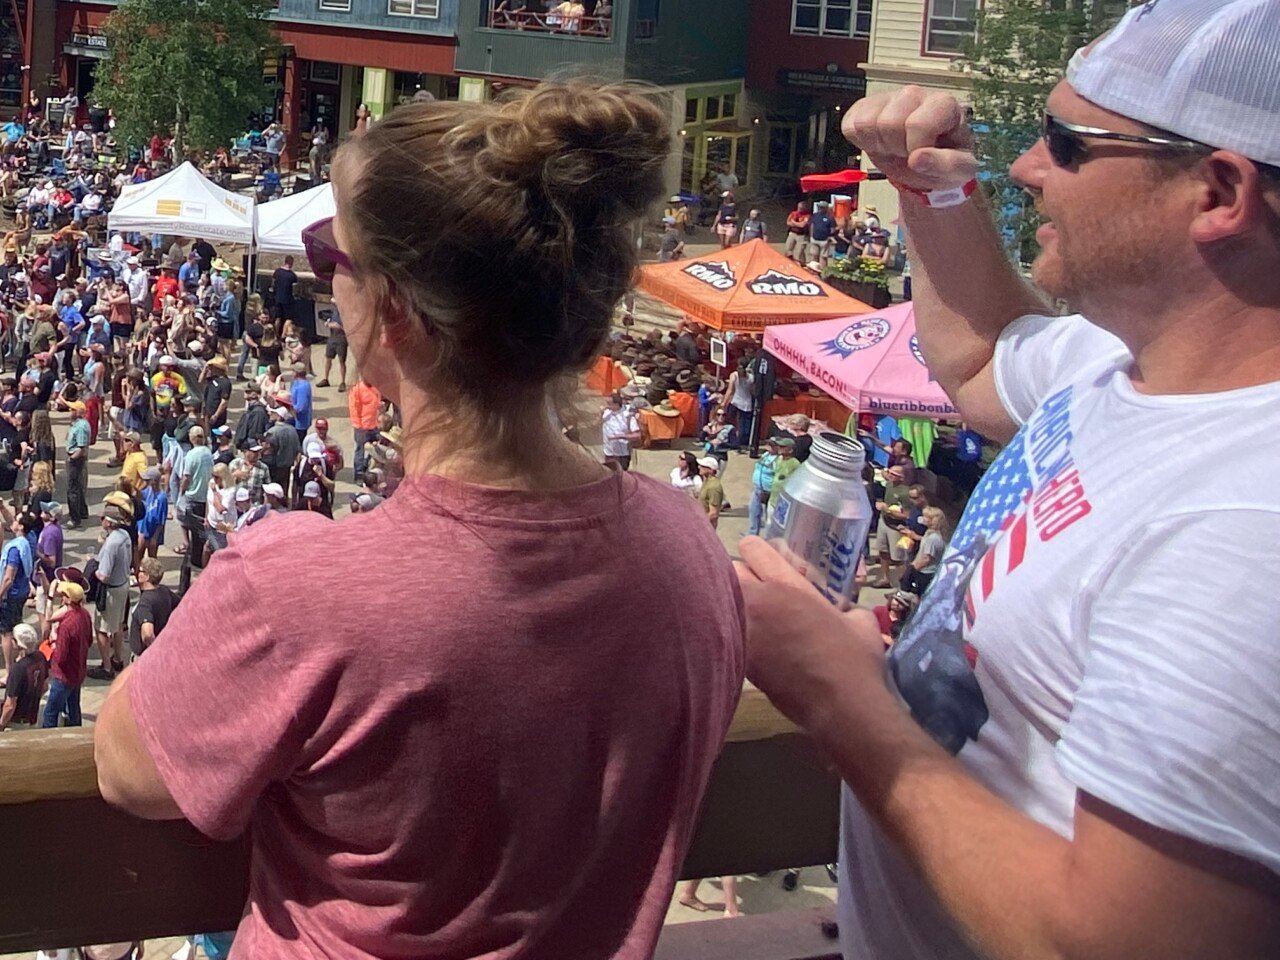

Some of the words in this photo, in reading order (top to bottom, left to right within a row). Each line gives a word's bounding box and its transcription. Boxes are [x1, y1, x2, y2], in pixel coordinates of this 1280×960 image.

[685, 264, 734, 290] RMO
[751, 282, 821, 296] RMO
[773, 338, 810, 373] OHHHH,
[811, 361, 848, 396] BACON!
[1033, 468, 1093, 542] HERO
